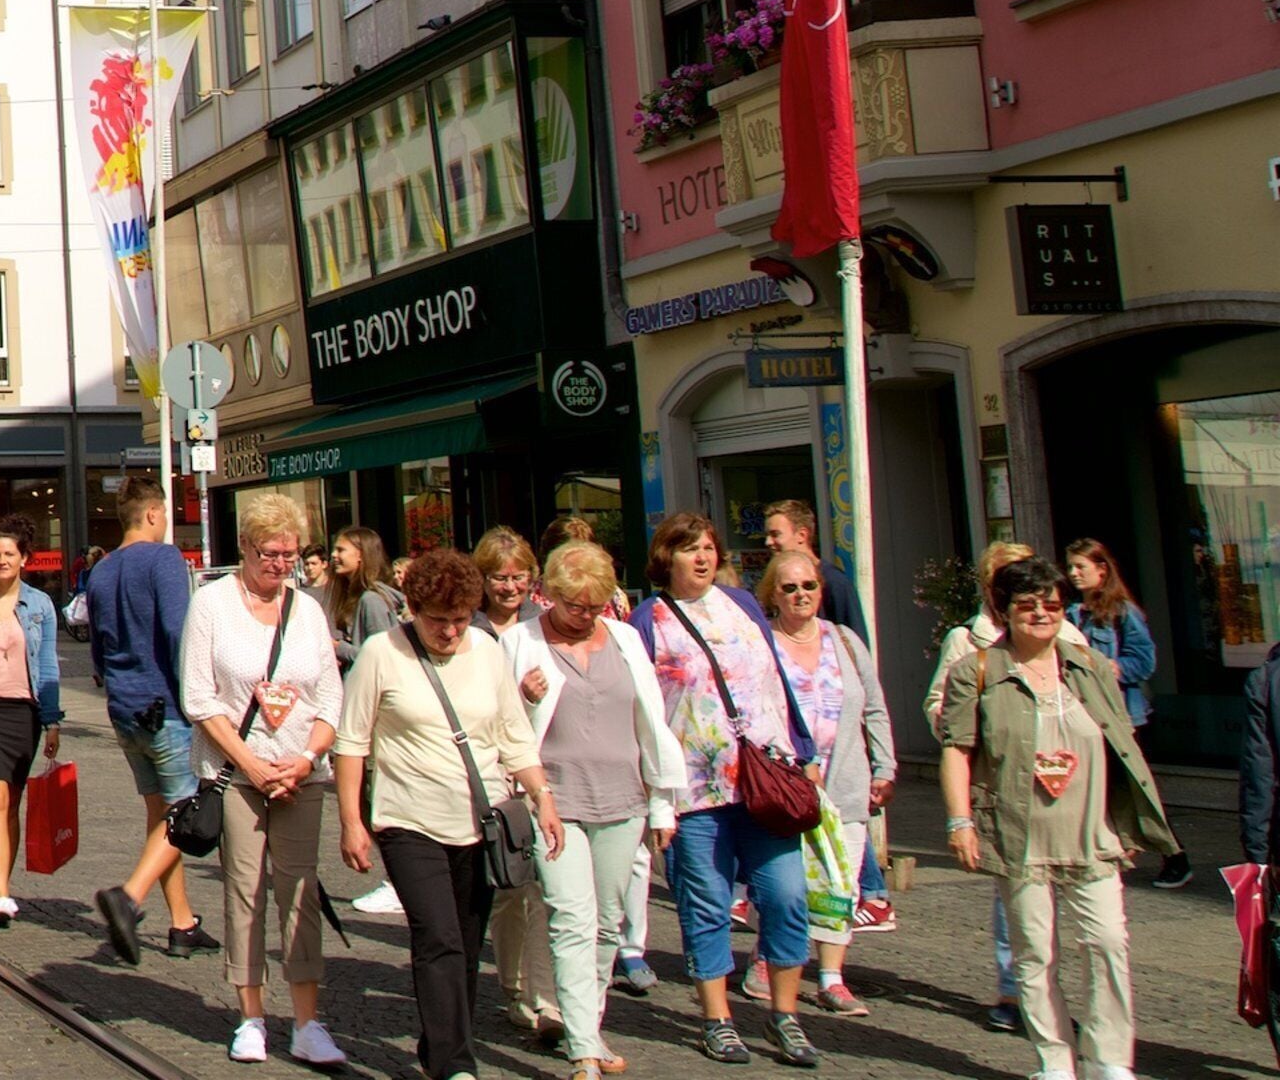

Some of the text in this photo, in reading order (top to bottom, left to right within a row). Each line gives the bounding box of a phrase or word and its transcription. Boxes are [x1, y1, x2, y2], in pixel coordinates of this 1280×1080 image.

[658, 164, 728, 225] HOTE
[625, 275, 789, 337] GAMERS PARADIZ
[311, 285, 476, 369] THE BODY SHOP
[761, 356, 837, 379] HOTEL
[563, 385, 597, 396] BODY
[569, 377, 589, 386] THE
[566, 396, 597, 407] SHOP
[984, 393, 999, 411] 32
[224, 452, 264, 479] ENDRES
[270, 456, 287, 477] THE
[289, 452, 314, 475] BODY
